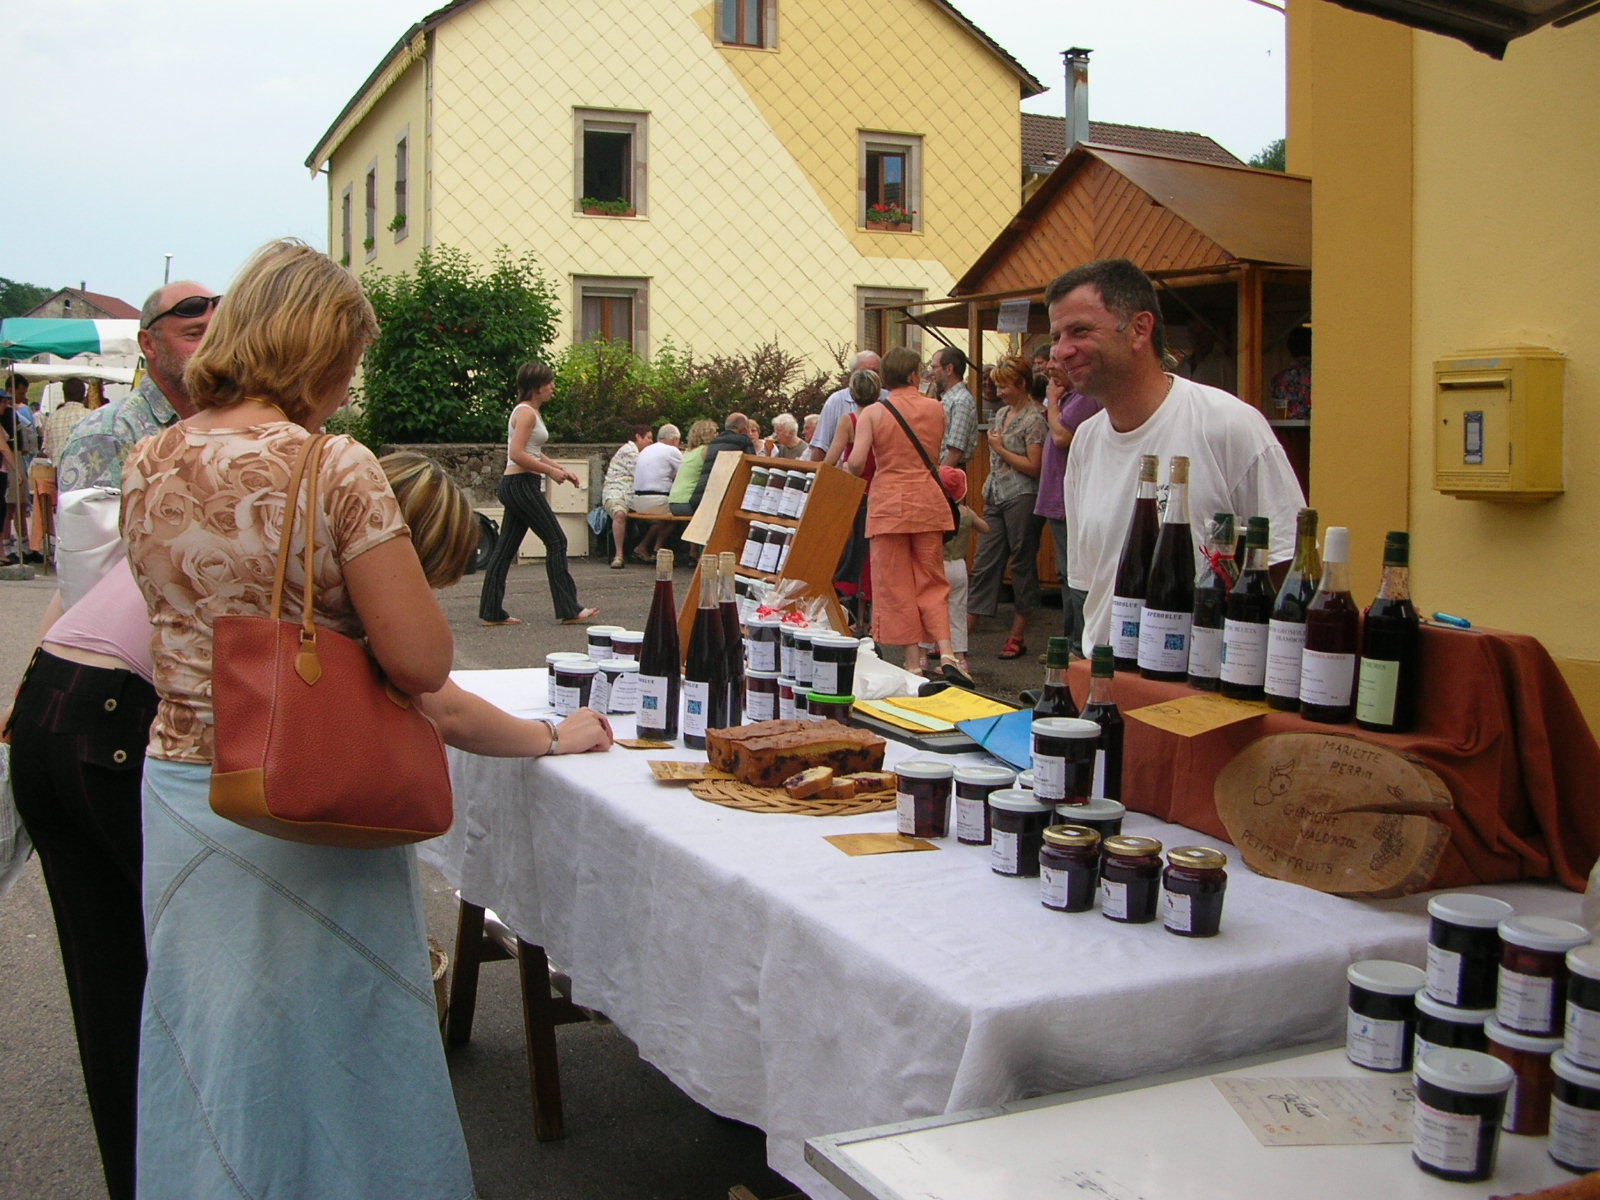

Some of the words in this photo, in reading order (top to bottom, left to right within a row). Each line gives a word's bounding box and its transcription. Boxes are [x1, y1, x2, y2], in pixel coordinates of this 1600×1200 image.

[1323, 740, 1383, 764] MARIETTE
[1282, 803, 1339, 826] GIRMONT
[1241, 829, 1278, 861] PETITS
[1287, 855, 1334, 875] FRUITS
